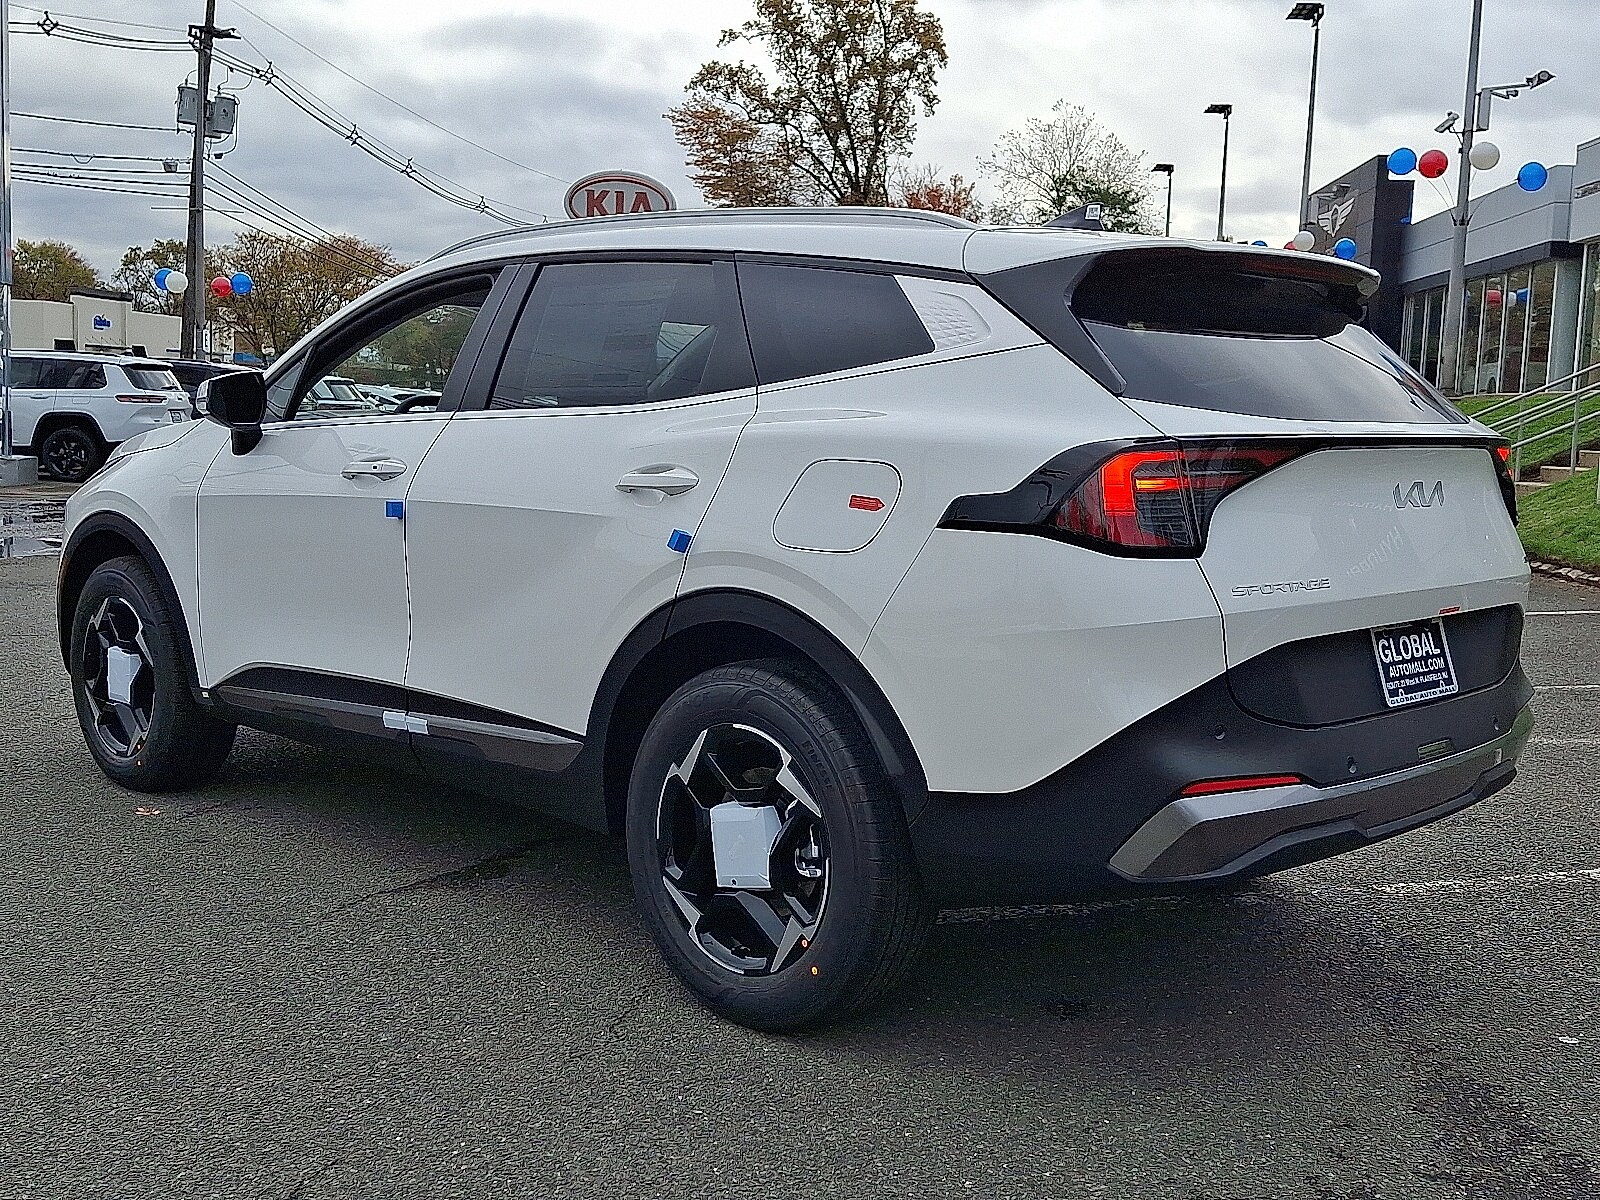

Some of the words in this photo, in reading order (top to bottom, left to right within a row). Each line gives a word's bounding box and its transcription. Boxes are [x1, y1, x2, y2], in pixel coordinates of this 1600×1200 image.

[585, 189, 652, 217] KIA
[1231, 578, 1331, 597] SPORTAGE
[1379, 632, 1440, 663] GLOBAL
[1389, 657, 1445, 678] AUTOMALL.COM
[1390, 695, 1418, 704] GLOBAL
[1419, 691, 1437, 699] AUTO
